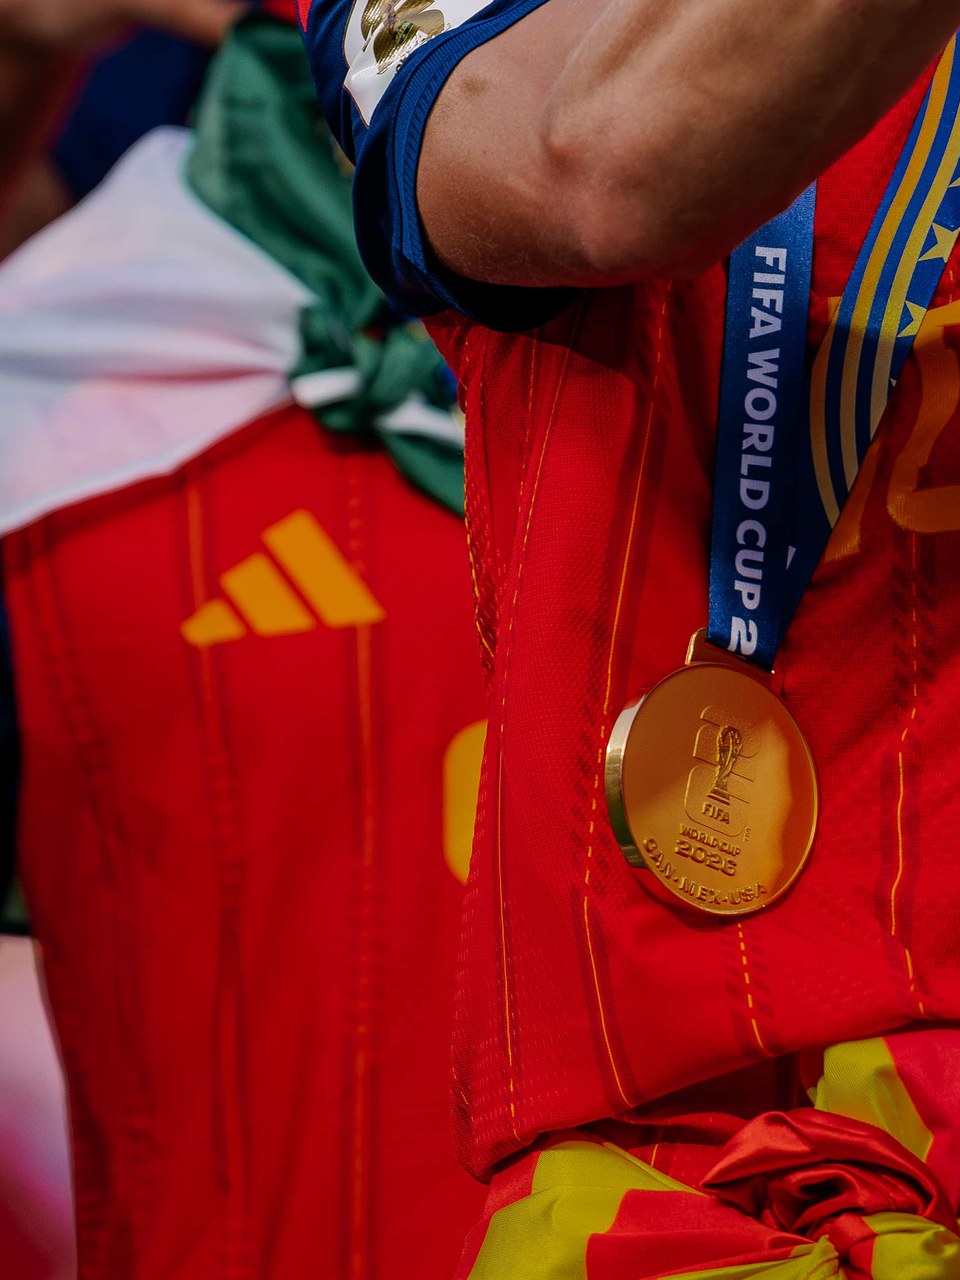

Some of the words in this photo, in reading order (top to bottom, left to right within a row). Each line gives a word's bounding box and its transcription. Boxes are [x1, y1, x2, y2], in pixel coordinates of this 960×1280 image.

[748, 245, 788, 340] FIFA
[738, 347, 780, 511] WORLD
[733, 519, 768, 611] CUP
[678, 823, 718, 848] WORLD
[718, 840, 741, 857] CUP
[702, 803, 729, 825] FIFA
[674, 838, 737, 877] 2026
